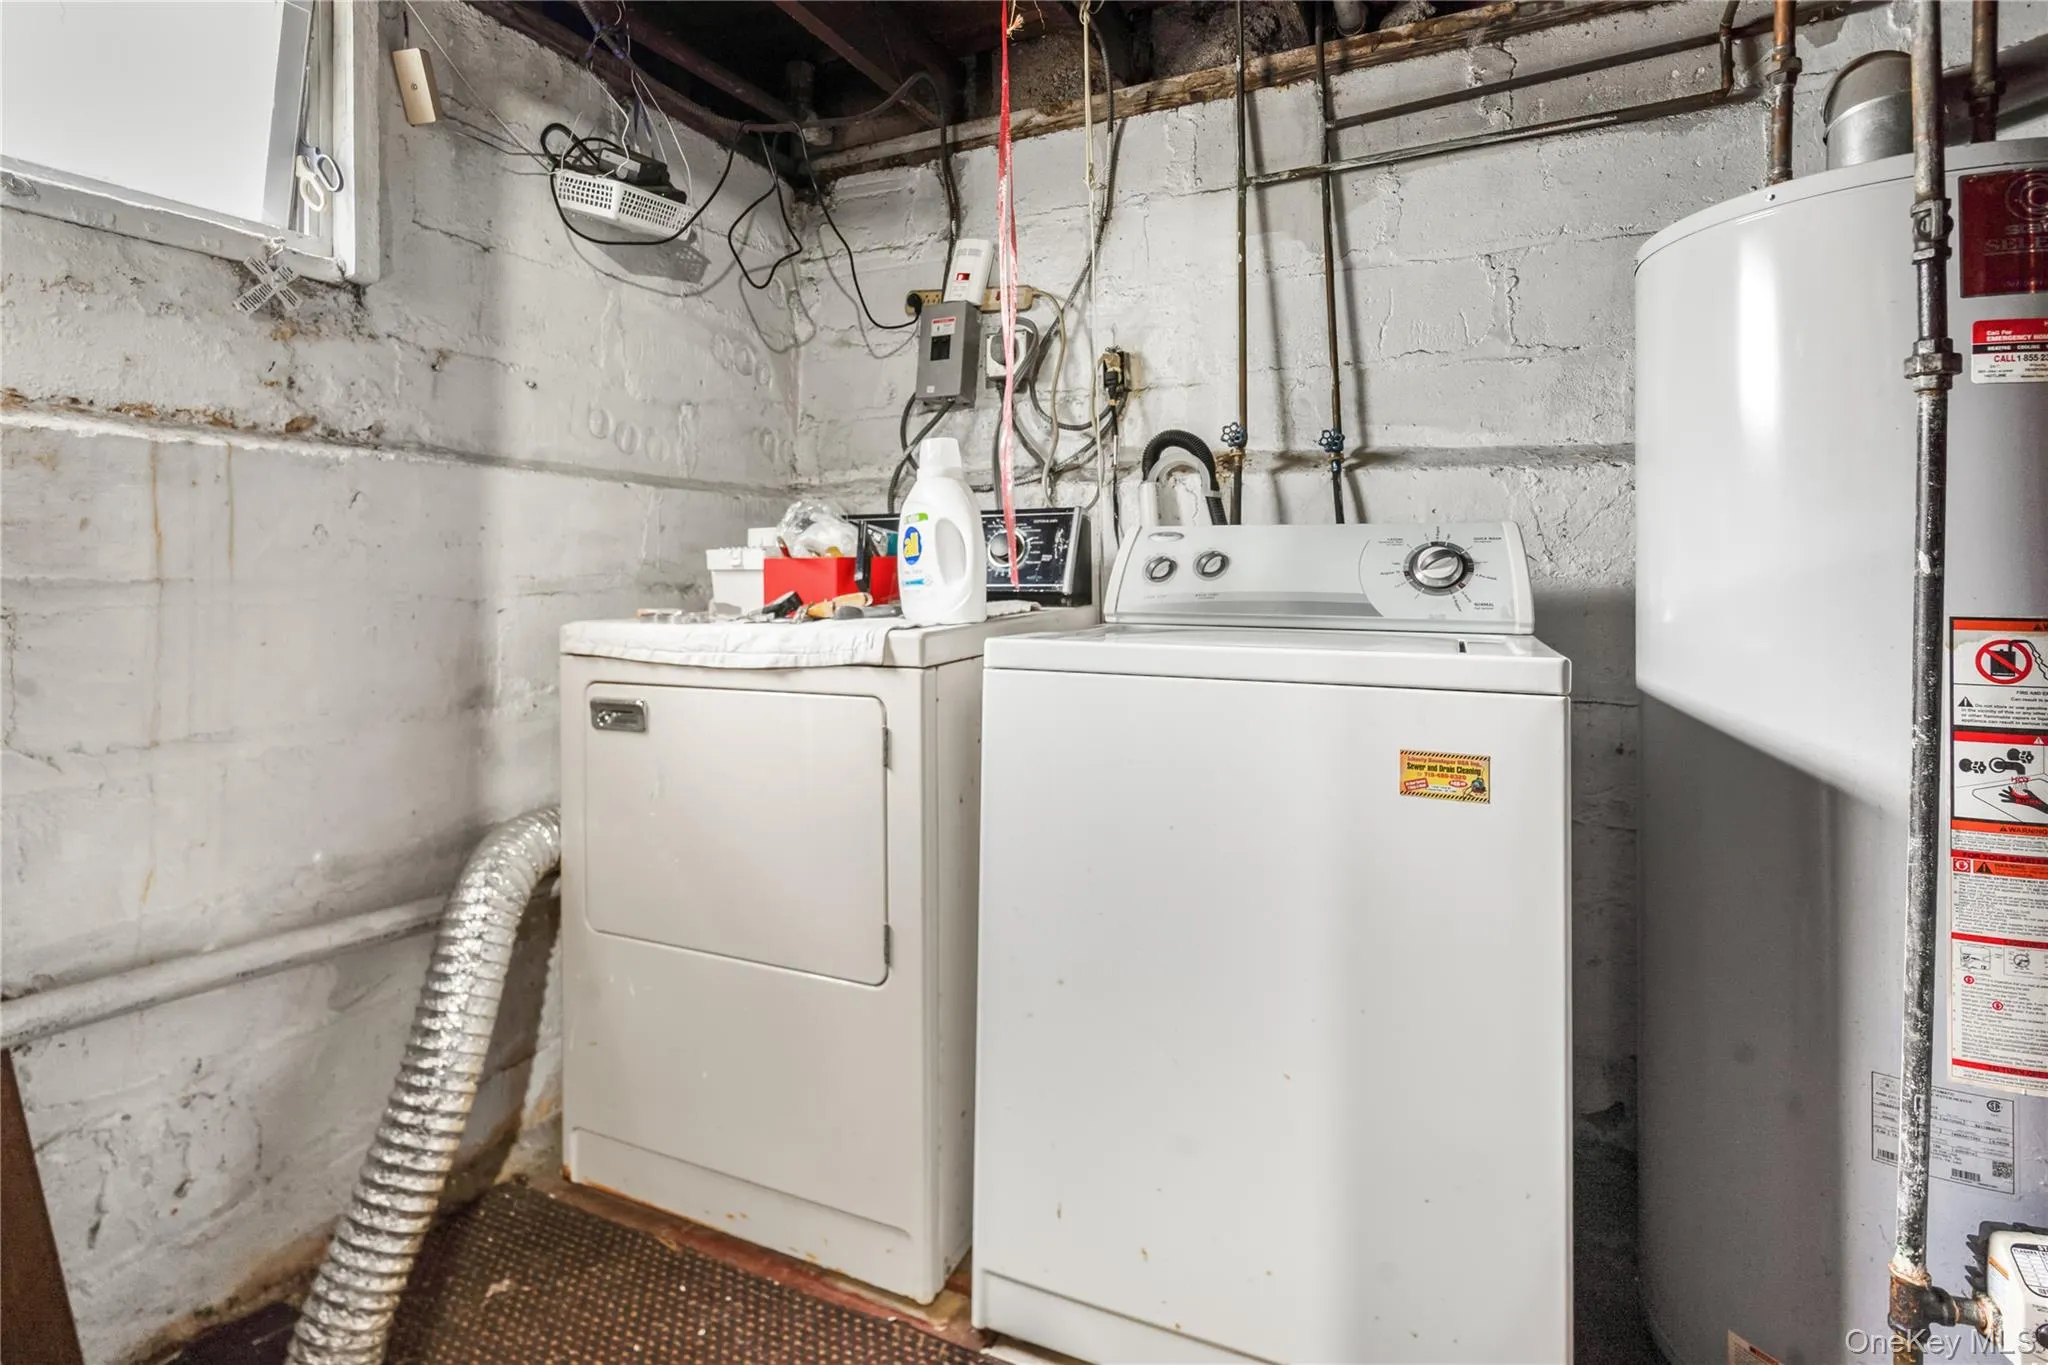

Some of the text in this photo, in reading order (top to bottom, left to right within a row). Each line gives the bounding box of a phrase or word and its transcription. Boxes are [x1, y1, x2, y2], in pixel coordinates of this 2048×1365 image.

[1993, 354, 2016, 362] CALL
[1406, 762, 1426, 770] Sewer
[1439, 765, 1456, 773] Drain
[1456, 766, 1482, 776] Cleaning
